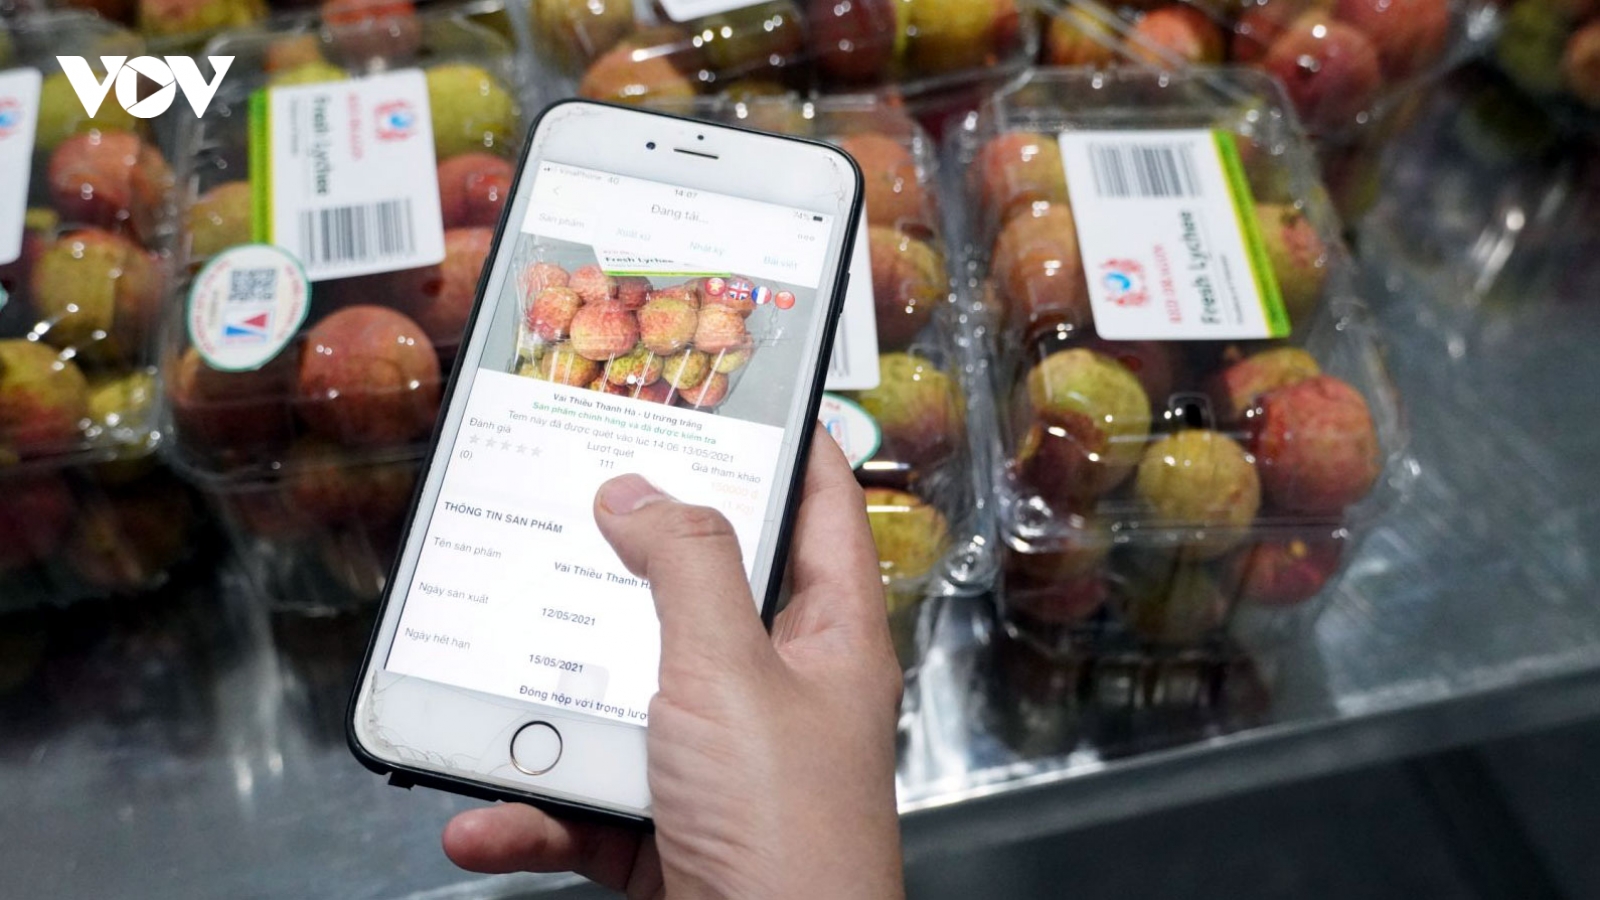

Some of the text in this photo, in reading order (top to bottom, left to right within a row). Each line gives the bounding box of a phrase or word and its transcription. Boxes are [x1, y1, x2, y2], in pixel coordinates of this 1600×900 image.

[651, 203, 682, 223] Đang
[1180, 210, 1221, 324] Fresh Lychee
[596, 401, 622, 414] Thanh
[624, 407, 636, 417] Hà
[509, 410, 528, 421] Tem
[530, 415, 547, 427] này
[683, 445, 734, 463] 13/05/2021
[704, 436, 717, 445] tra
[460, 449, 473, 461] (0)
[599, 459, 615, 469] 111
[711, 466, 735, 478] tham
[445, 501, 482, 517] THÔNG
[485, 510, 503, 521] TIN
[530, 518, 563, 534] PHẨM
[433, 536, 452, 548] Tên
[573, 565, 603, 580] Thiều
[606, 572, 638, 587] Thanh
[640, 579, 650, 589] H
[419, 581, 445, 596] Ngày
[541, 607, 596, 627] 12/05/2021
[404, 627, 431, 642] Ngày
[433, 632, 449, 645] hết
[529, 653, 584, 673] 15/05/2021
[519, 684, 548, 701] Đóng
[551, 691, 572, 706] hộp
[575, 698, 594, 709] với
